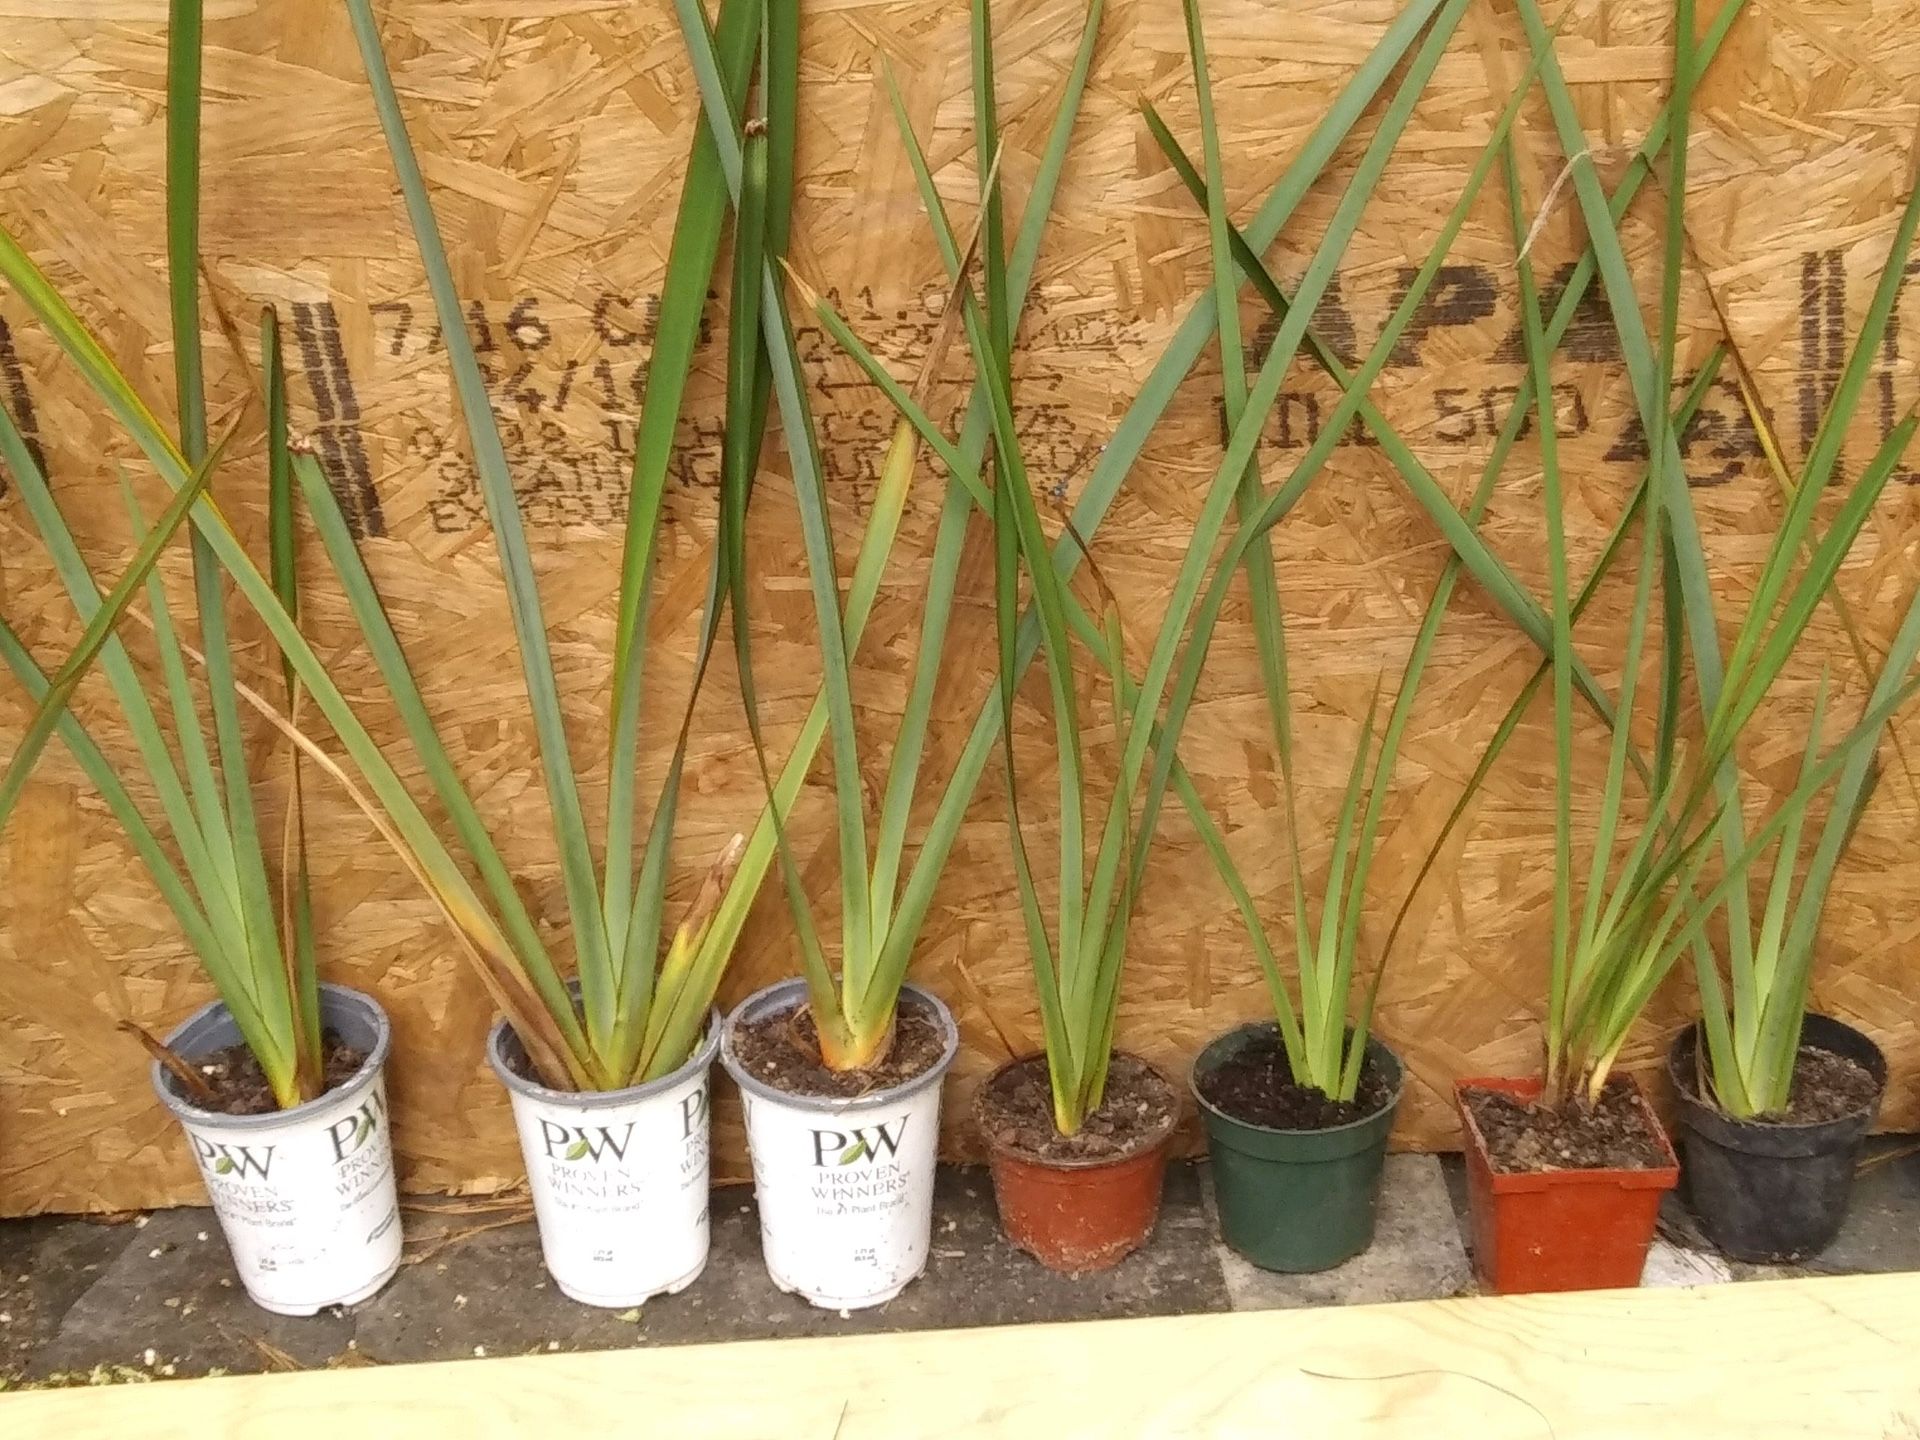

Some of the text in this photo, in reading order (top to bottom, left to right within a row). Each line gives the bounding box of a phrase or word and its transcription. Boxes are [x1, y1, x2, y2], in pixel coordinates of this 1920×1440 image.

[191, 1131, 277, 1182] PW
[536, 1117, 638, 1165] PW
[808, 1112, 912, 1168] PW
[811, 1174, 907, 1201] WINNERS
[819, 1160, 901, 1185] PROVEN
